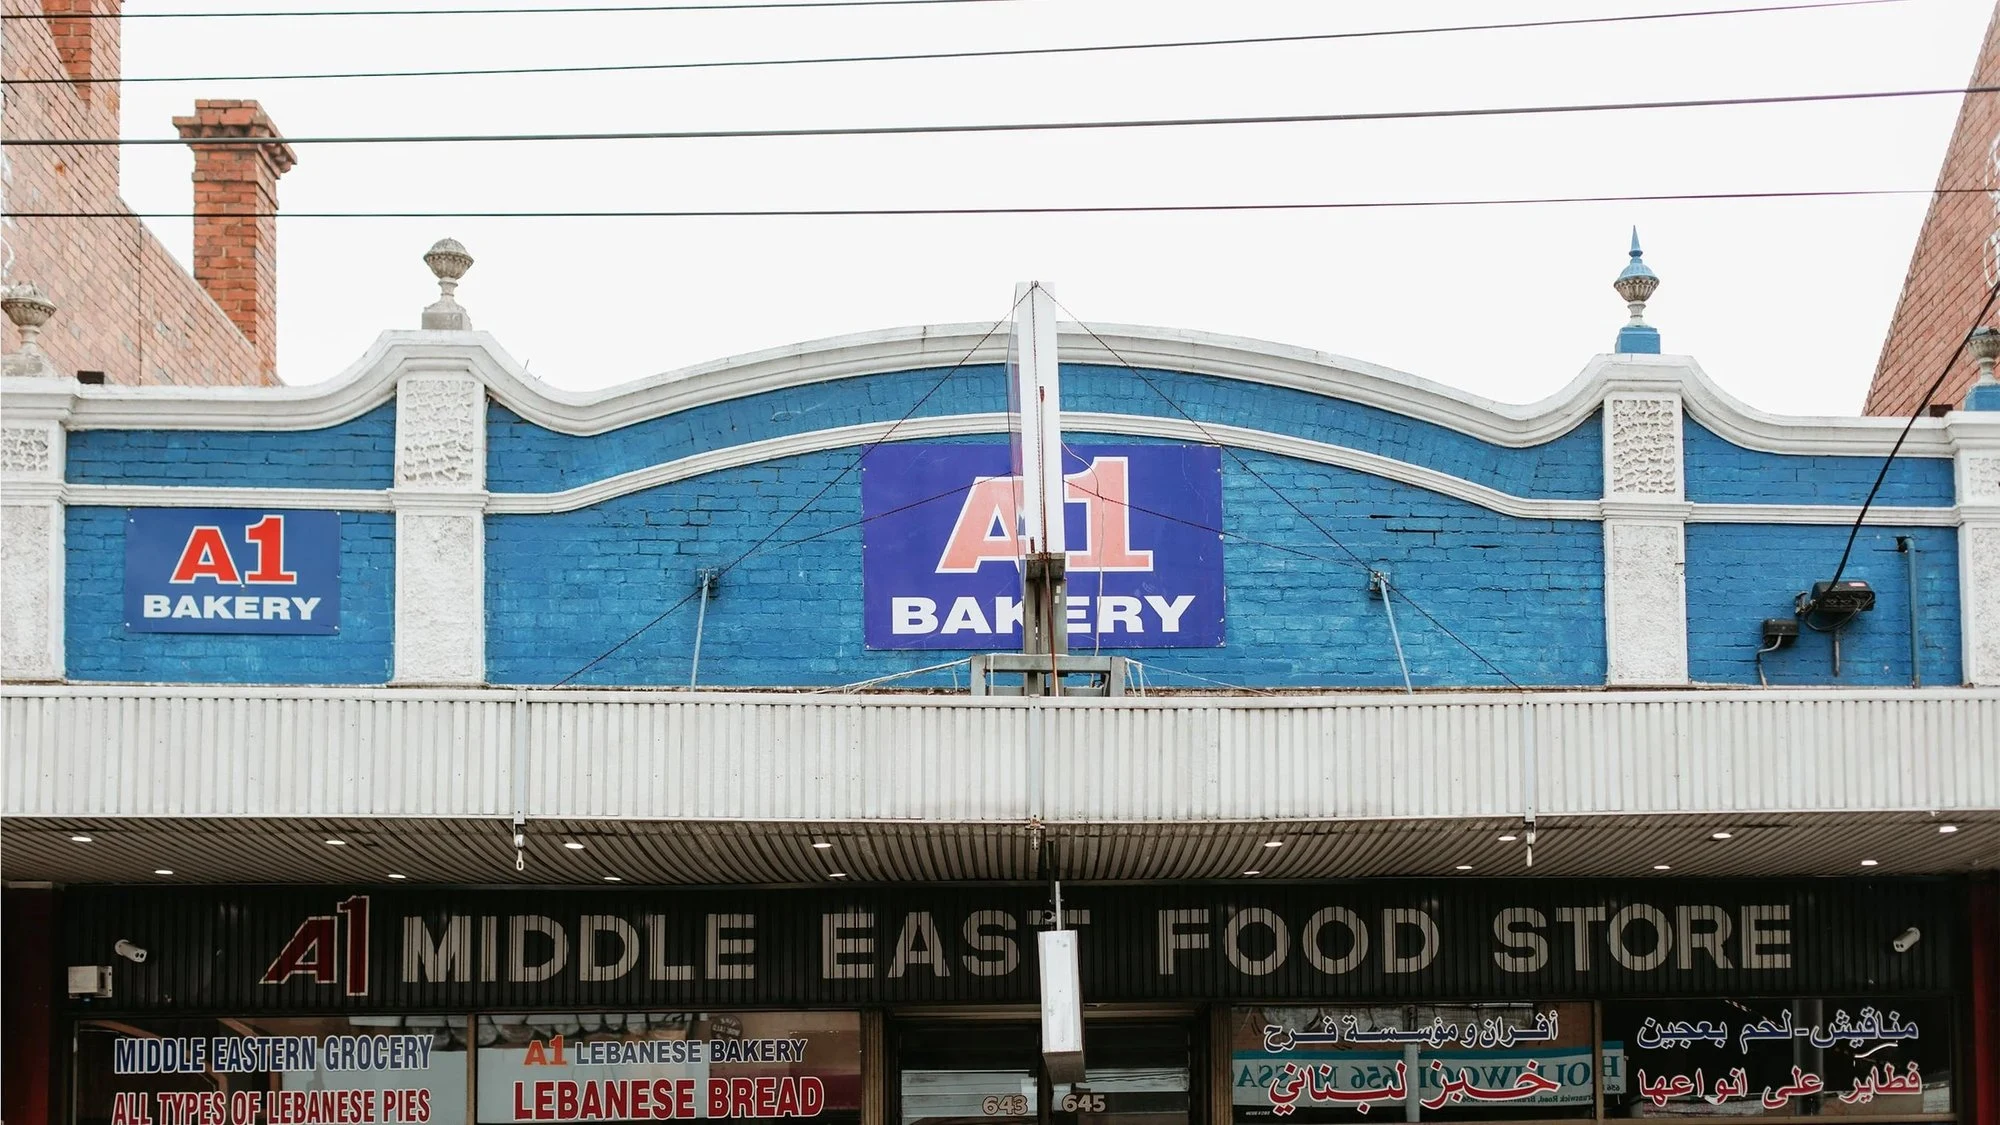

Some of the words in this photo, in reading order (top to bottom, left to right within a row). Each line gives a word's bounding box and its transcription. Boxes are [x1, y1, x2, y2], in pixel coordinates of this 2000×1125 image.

[935, 456, 1154, 573] A1
[169, 514, 297, 585] A1
[143, 595, 321, 621] BAKERY
[259, 895, 370, 996] A1
[402, 912, 755, 983] MIDDLE
[1158, 906, 1440, 976] FOOD
[1493, 903, 1792, 974] STORE
[523, 1034, 569, 1066] A1
[575, 1039, 703, 1066] LEBANESE
[709, 1038, 808, 1064] BAKERY
[1263, 1016, 1339, 1053] فرح
[1637, 1017, 1728, 1050] بعجين
[114, 1038, 206, 1074] MIDDLE
[212, 1036, 317, 1073] EASTERN
[325, 1034, 435, 1072] GROCERY
[513, 1077, 696, 1121] LEBANESE
[706, 1076, 825, 1119] BREAD
[1269, 1059, 1409, 1117] لبناني
[1420, 1057, 1561, 1111] خبز
[111, 1092, 153, 1125] ALL
[157, 1091, 225, 1125] TYPES
[231, 1090, 262, 1125] OF
[267, 1089, 376, 1125] LEBANESE
[383, 1088, 432, 1124] PIES
[981, 1094, 1029, 1116] 643
[1061, 1093, 1107, 1114] 645
